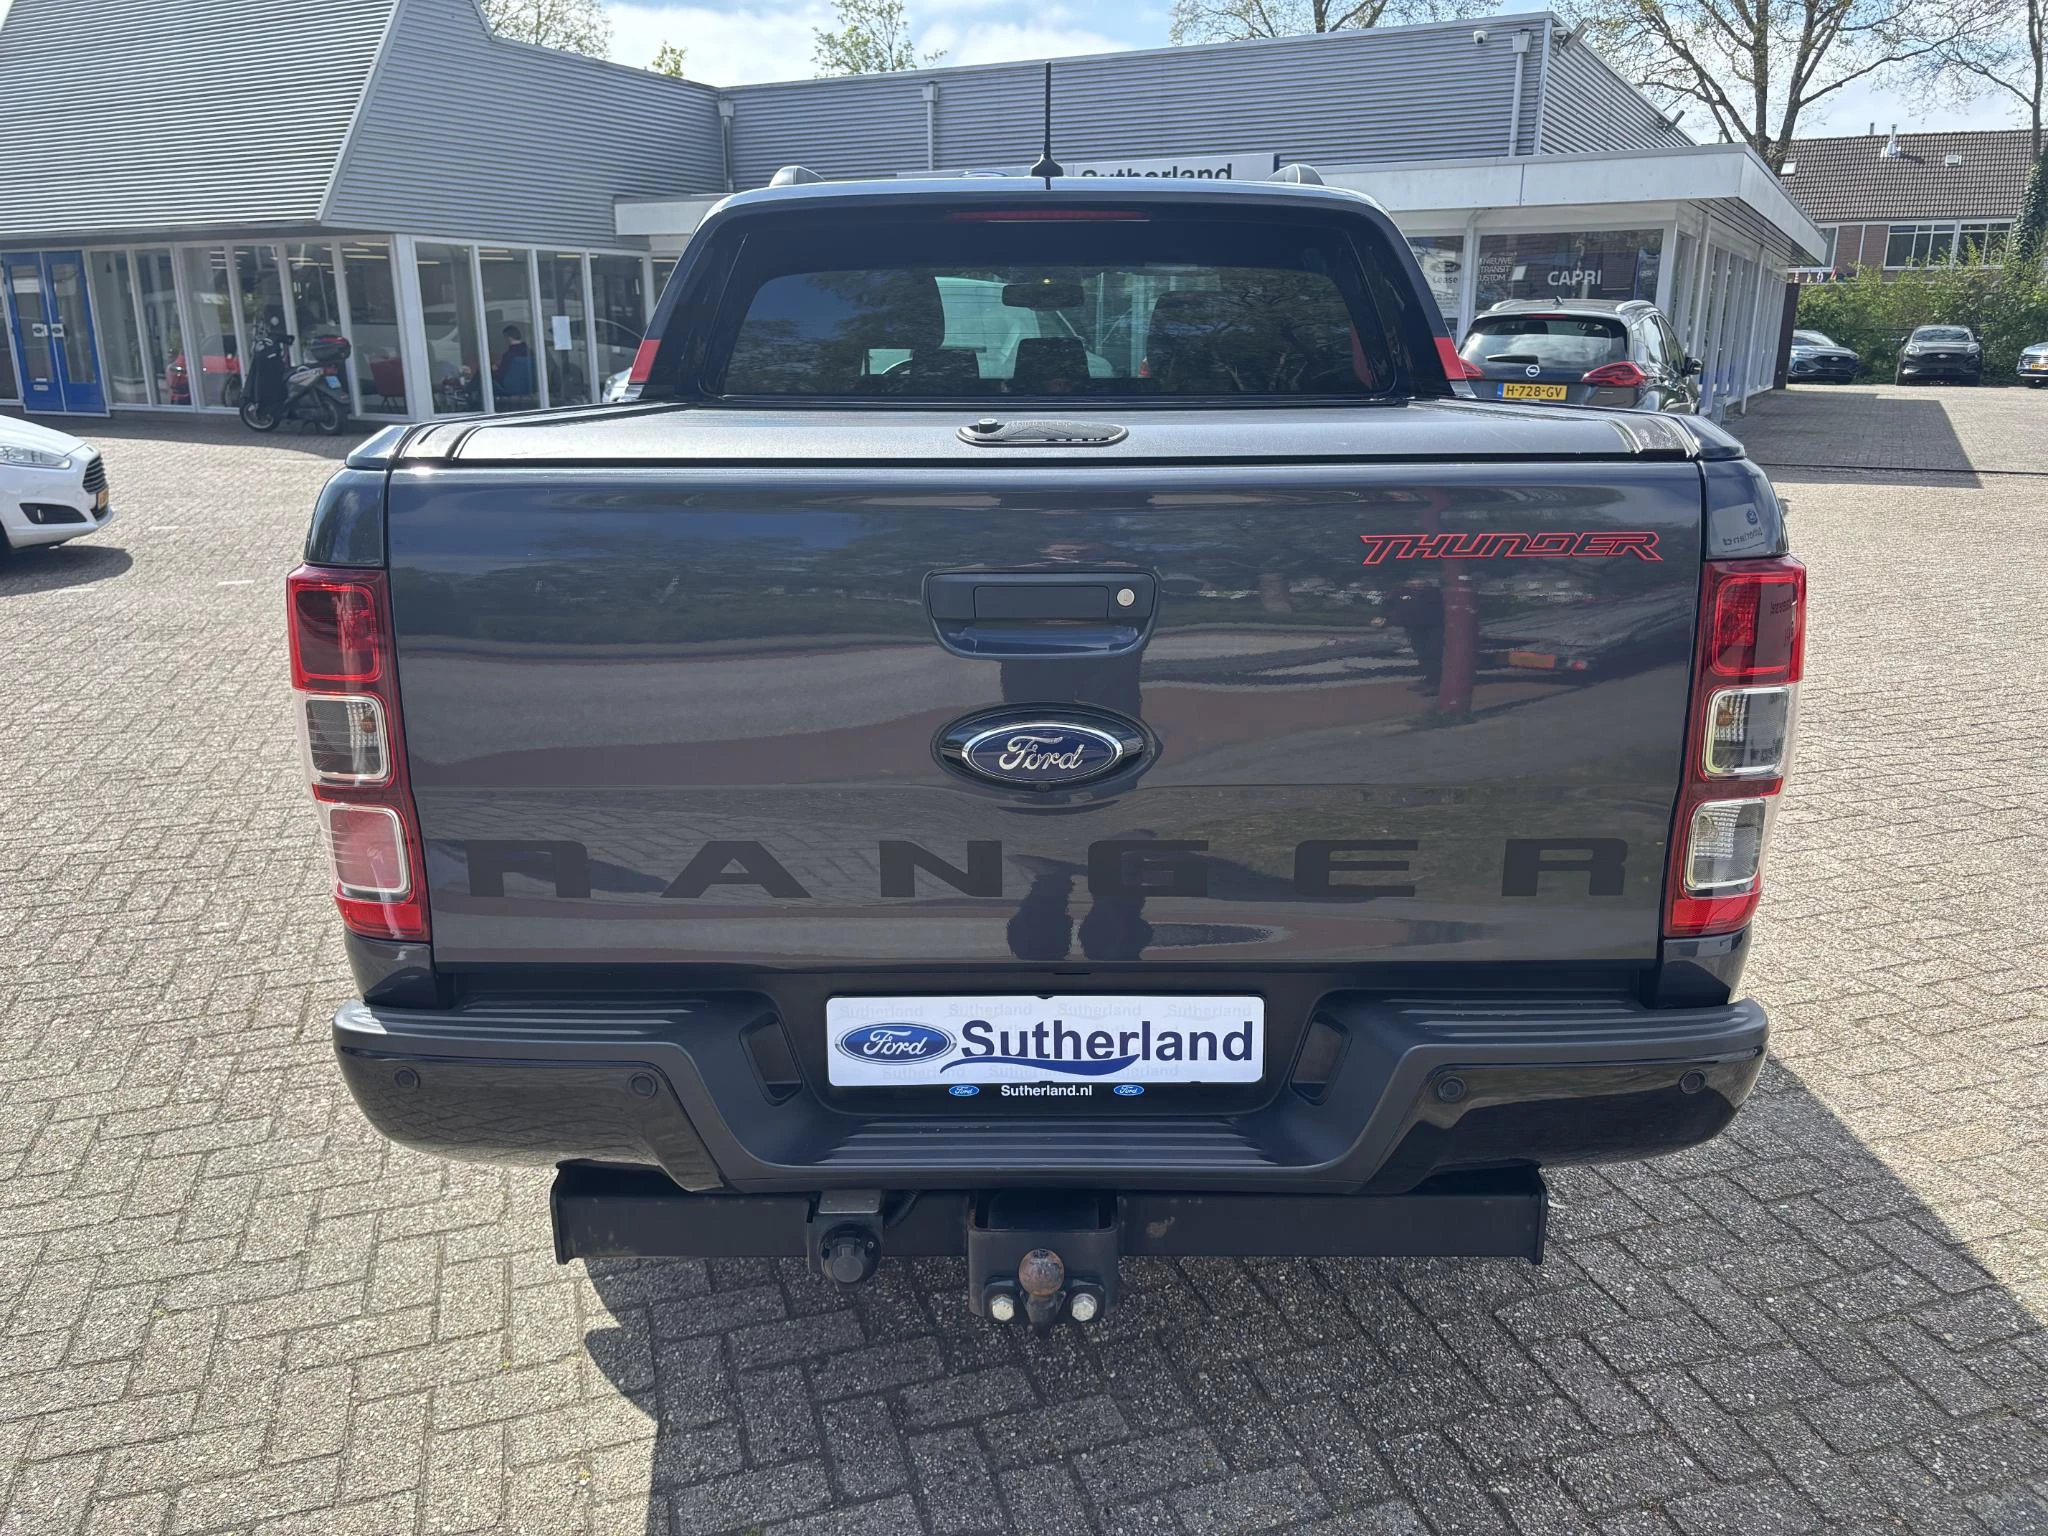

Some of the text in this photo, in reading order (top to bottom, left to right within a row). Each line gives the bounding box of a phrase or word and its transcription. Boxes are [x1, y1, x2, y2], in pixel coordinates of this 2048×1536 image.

[1081, 163, 1233, 180] therland
[1479, 274, 1507, 282] USTOM
[1547, 270, 1602, 286] CAPRI
[1506, 385, 1562, 398] H-728-GV
[1360, 531, 1663, 565] THUNDER
[998, 734, 1087, 771] Ford
[464, 837, 1628, 899] RANGER
[863, 1029, 928, 1056] Ford
[961, 1019, 1253, 1062] Sutherland
[1001, 1084, 1093, 1097] Sutherland.nl
